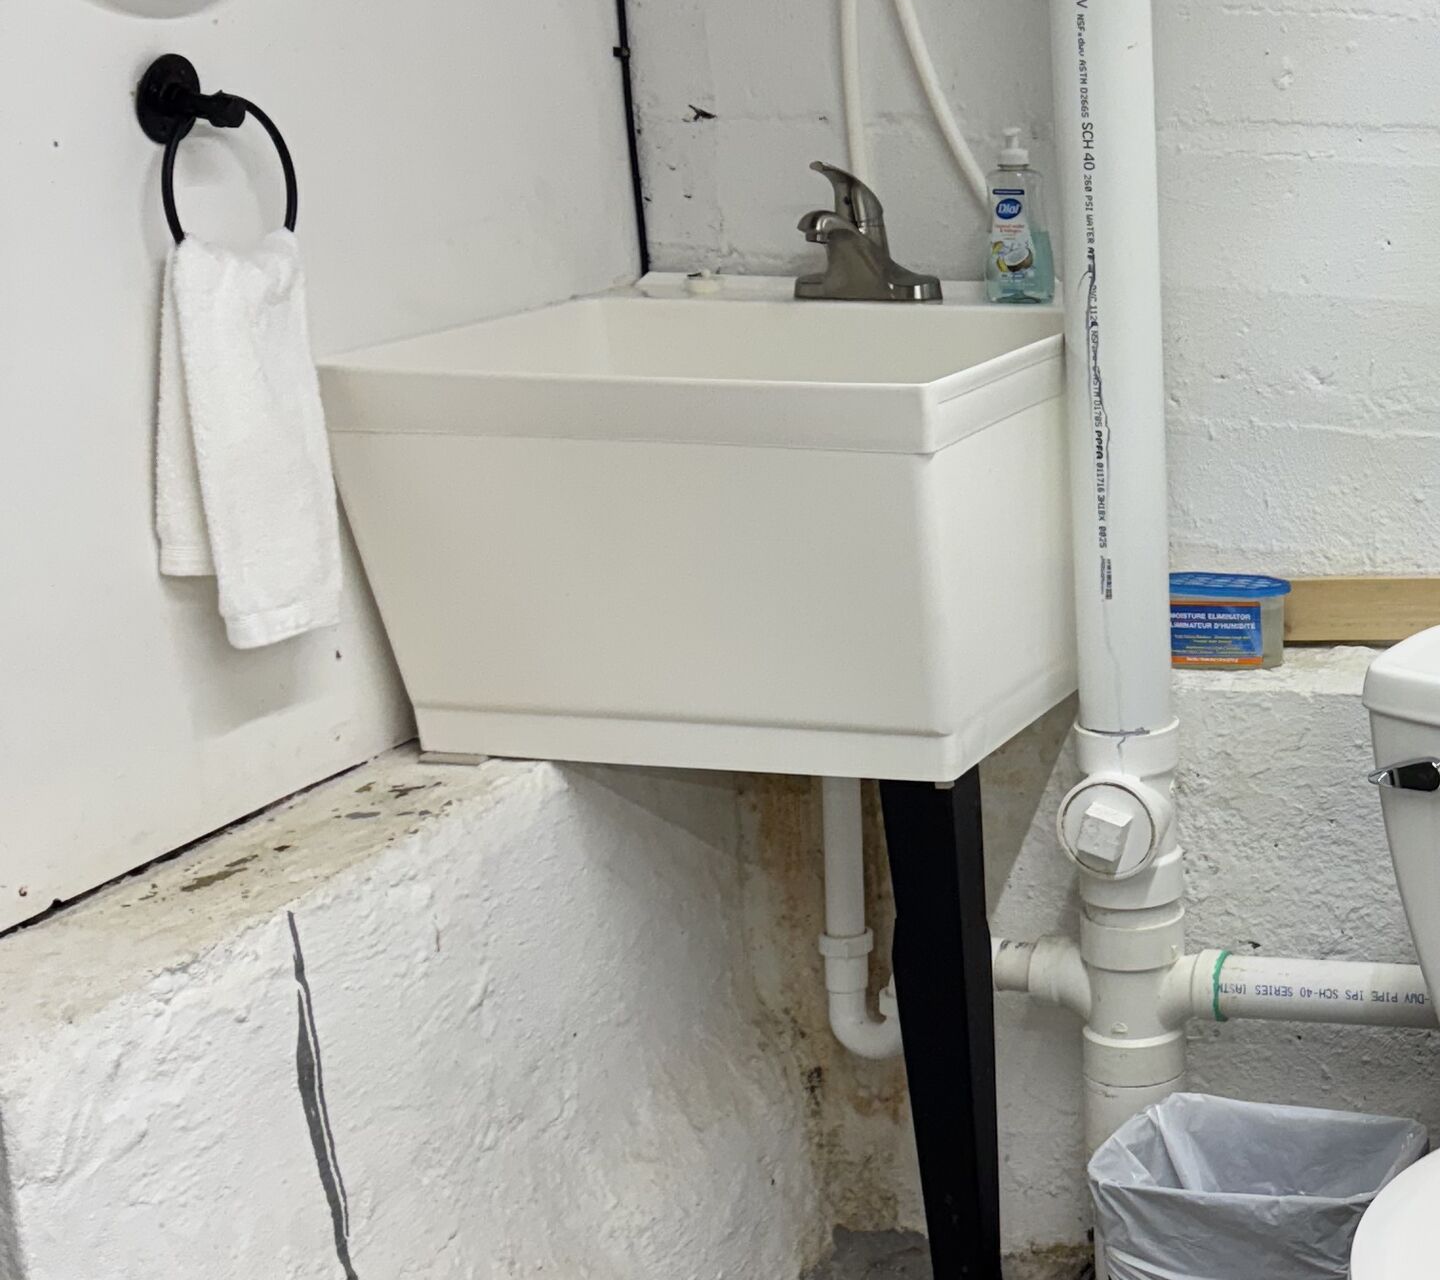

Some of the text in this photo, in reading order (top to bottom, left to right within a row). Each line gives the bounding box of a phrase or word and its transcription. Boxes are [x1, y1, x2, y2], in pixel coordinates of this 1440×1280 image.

[1081, 122, 1095, 150] SCH
[1083, 152, 1096, 171] 40
[1083, 174, 1094, 192] 260
[997, 203, 1021, 215] Dial
[1085, 195, 1094, 212] PSI
[1086, 214, 1095, 245] WATER
[1094, 430, 1104, 460] PPFA
[1208, 612, 1251, 621] ELIMINATOR
[1255, 984, 1294, 997] SERIES
[1299, 985, 1339, 1000] SCH-40
[1345, 989, 1364, 1001] IPS
[1371, 990, 1398, 1003] PIPE
